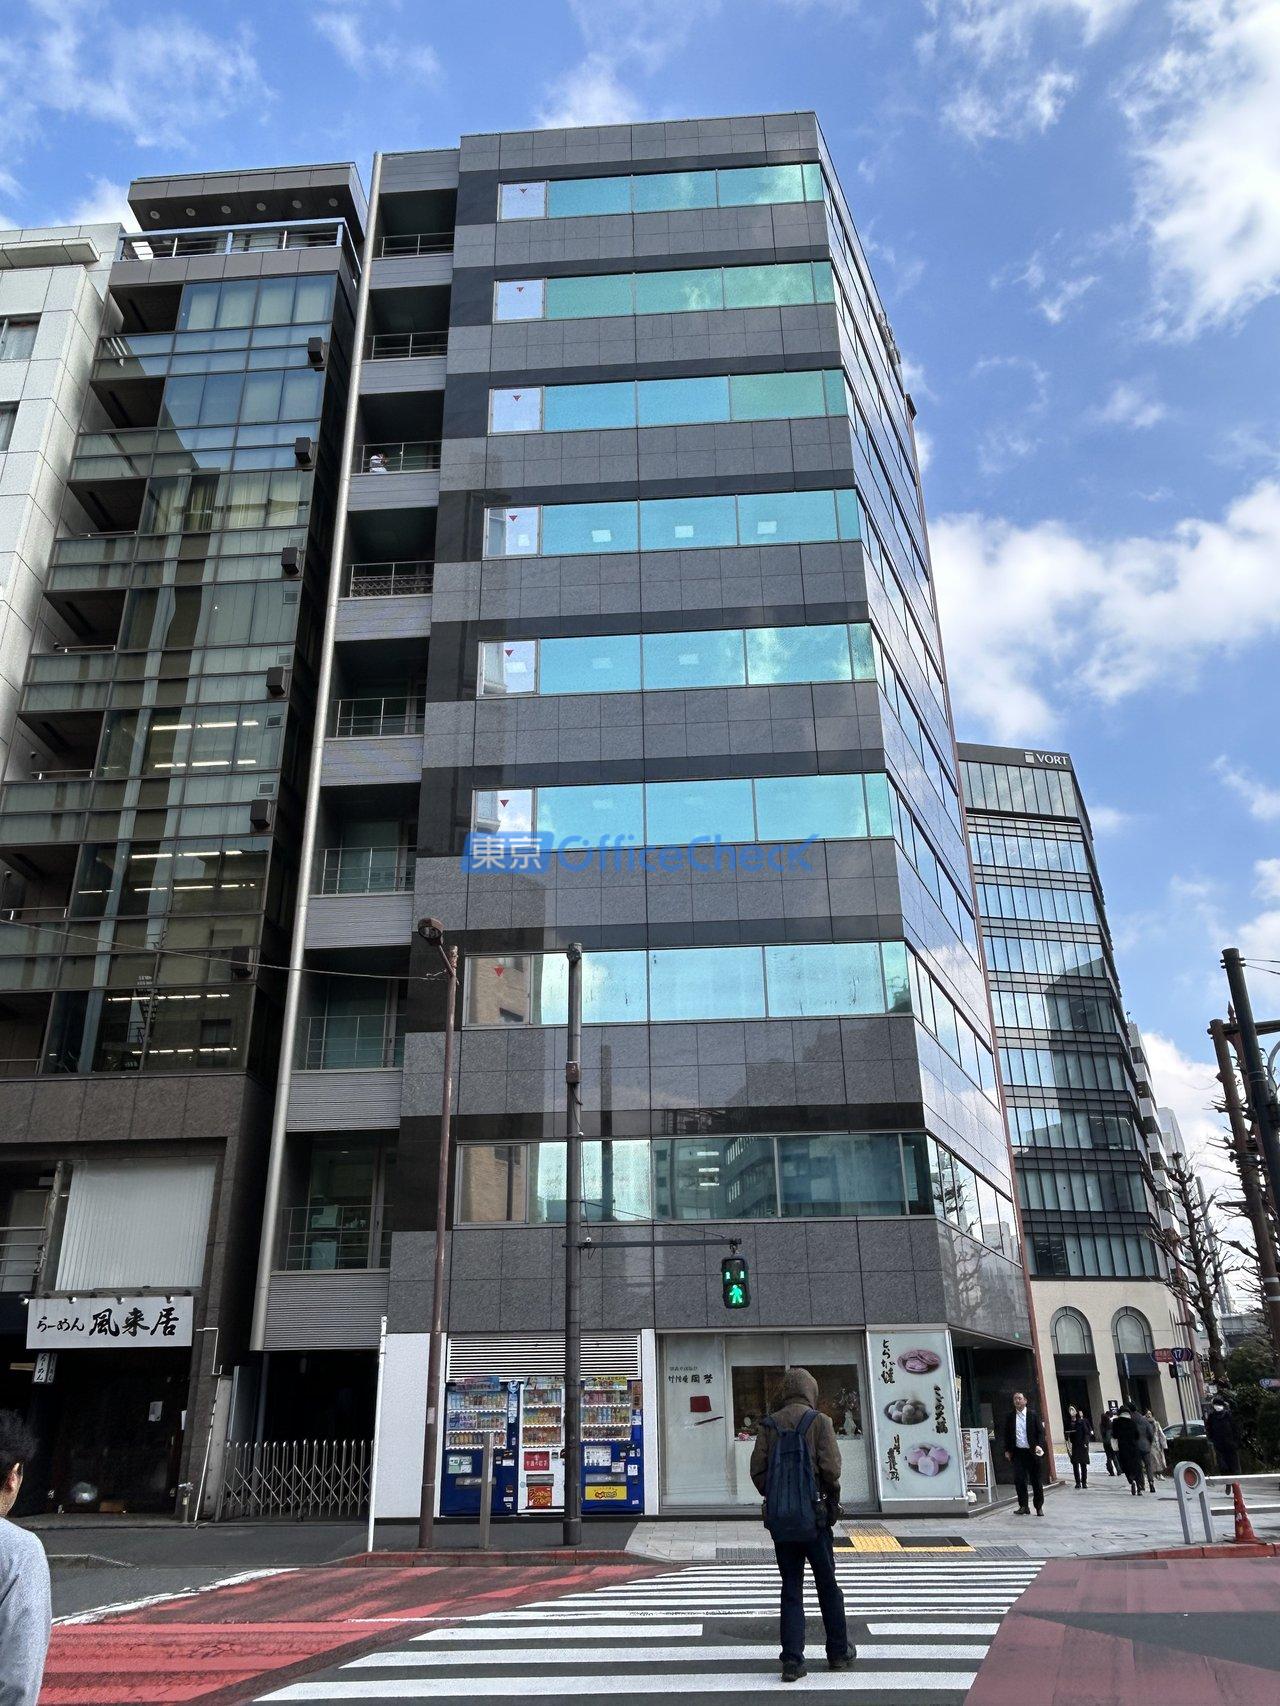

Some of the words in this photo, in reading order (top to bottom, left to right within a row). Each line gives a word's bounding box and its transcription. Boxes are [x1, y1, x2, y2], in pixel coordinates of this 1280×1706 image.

[1036, 753, 1068, 765] VORT
[37, 1316, 85, 1332] らーめん
[89, 1307, 179, 1337] 風来居
